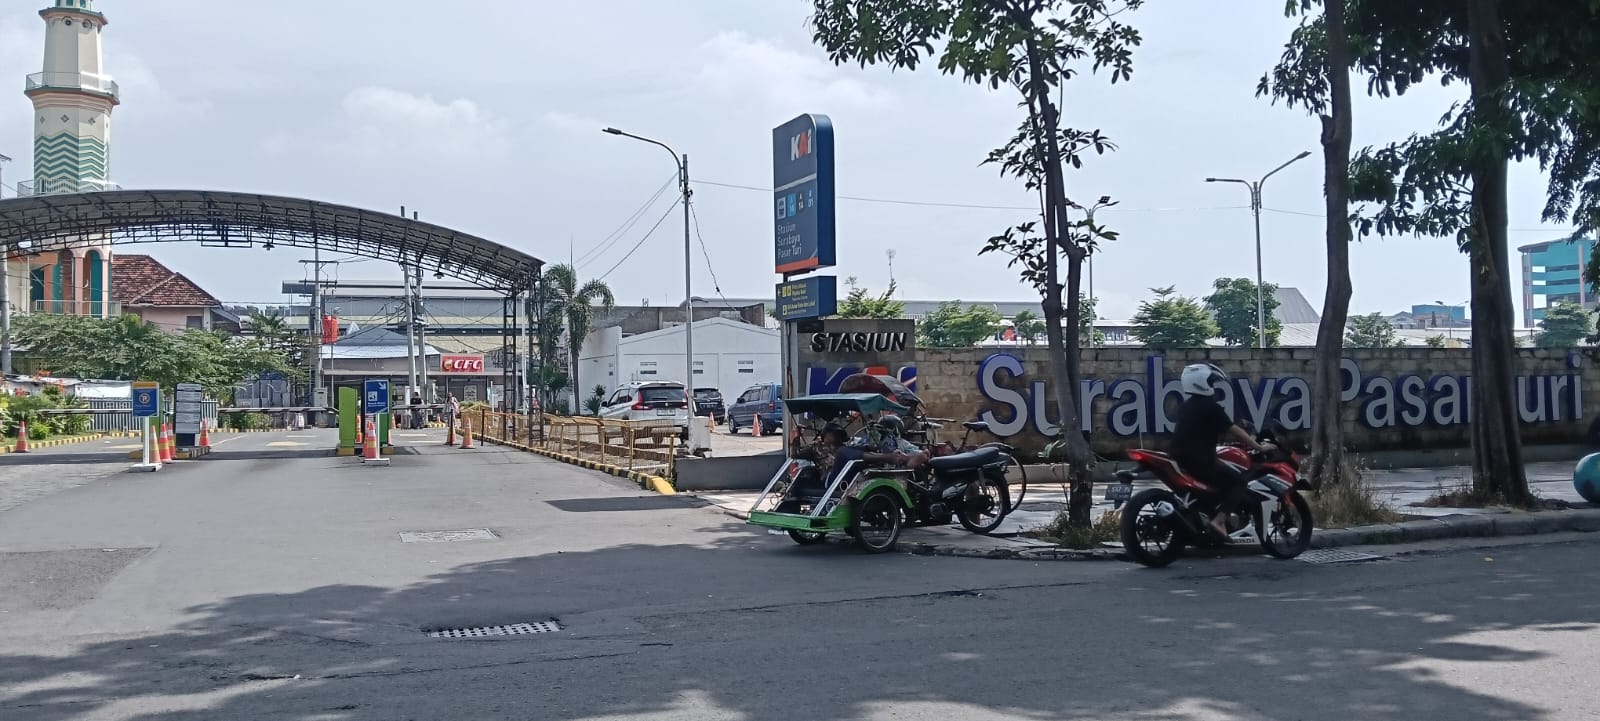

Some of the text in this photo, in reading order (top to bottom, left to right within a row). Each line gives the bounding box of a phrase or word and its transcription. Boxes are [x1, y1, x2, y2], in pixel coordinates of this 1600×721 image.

[777, 222, 796, 235] Stasiun
[777, 233, 801, 247] Surabaya
[809, 332, 907, 353] STASIUN
[453, 359, 483, 370] CFC
[1515, 351, 1584, 424] uri
